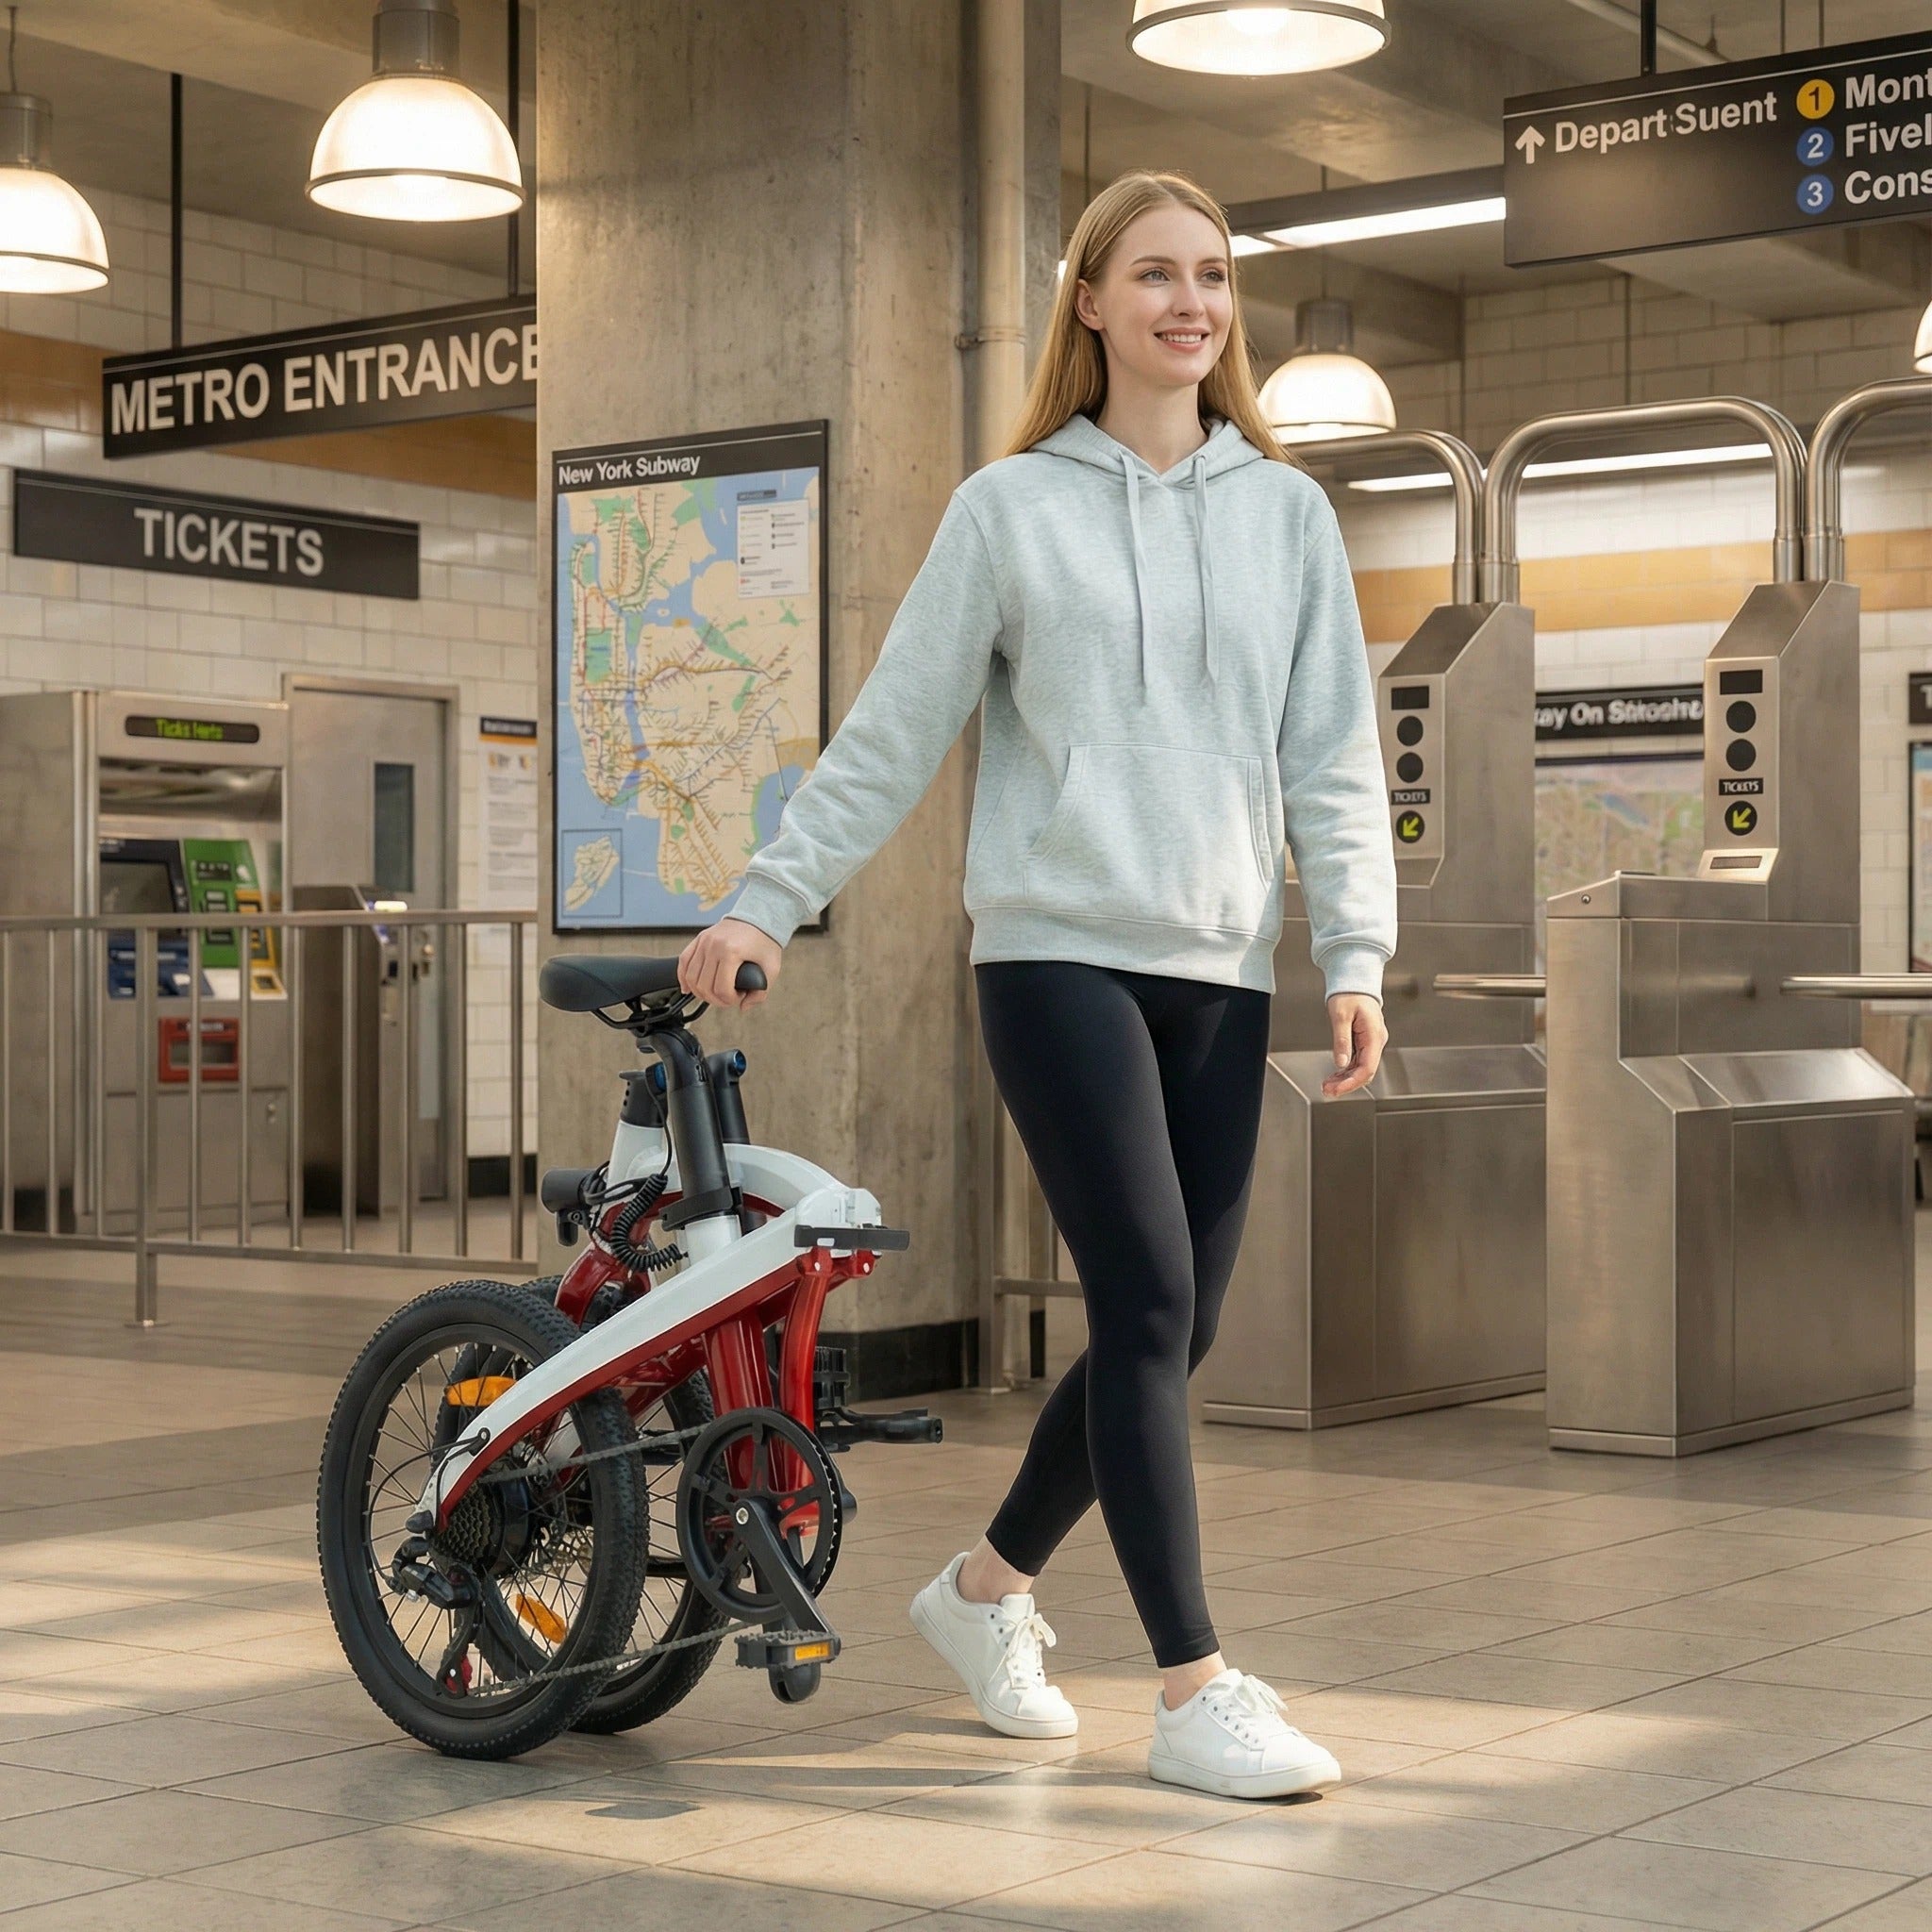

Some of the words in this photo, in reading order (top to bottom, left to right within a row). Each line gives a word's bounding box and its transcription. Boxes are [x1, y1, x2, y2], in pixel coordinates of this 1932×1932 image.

[1808, 86, 1820, 111] 1
[1555, 110, 1668, 154] Depart
[1675, 92, 1778, 134] Suent
[1807, 133, 1824, 159] 2
[1807, 181, 1824, 207] 3
[110, 362, 271, 435] METRO
[283, 325, 538, 413] ENTRANCE
[558, 466, 593, 486] New
[596, 459, 633, 481] York
[636, 456, 701, 477] Subway
[134, 508, 324, 577] TICKETS
[1570, 702, 1604, 726] On
